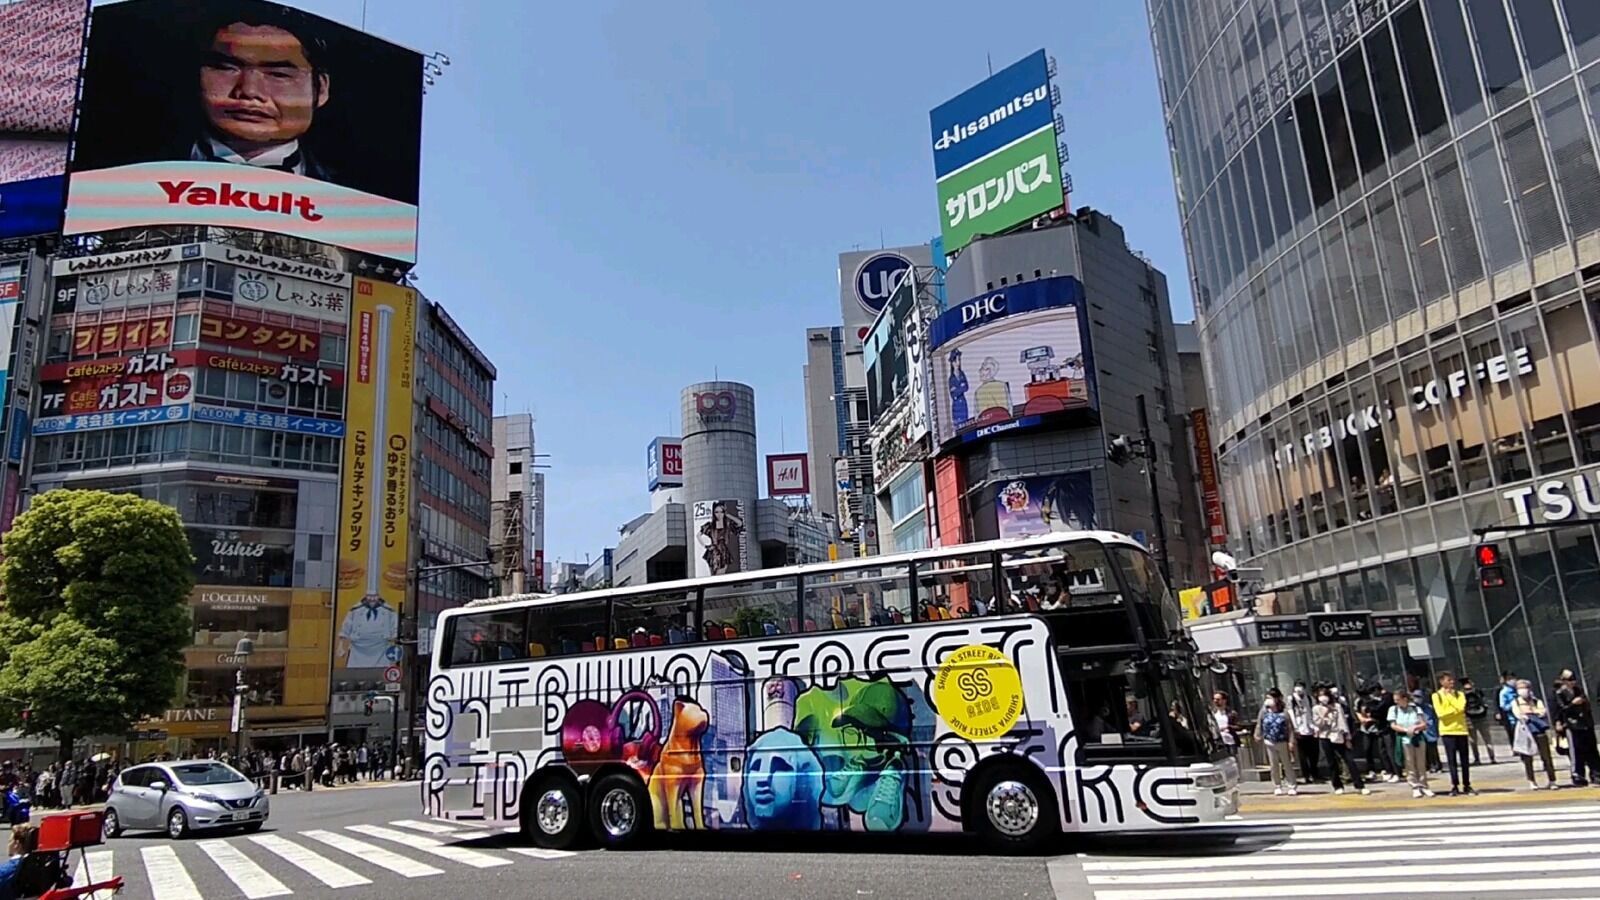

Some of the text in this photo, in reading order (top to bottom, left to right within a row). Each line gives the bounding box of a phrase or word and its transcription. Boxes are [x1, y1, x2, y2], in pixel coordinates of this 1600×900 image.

[934, 84, 1048, 150] Hisamitsu
[157, 180, 324, 223] Yakult
[946, 153, 1053, 228] サロンパス
[68, 248, 172, 272] しゃぶしゃぶバイキング
[225, 249, 345, 283] しゃぶしゃぶバイキング
[57, 288, 77, 303] 9F
[113, 272, 173, 297] しゃぶ葉
[275, 282, 344, 312] しゃぶ葉
[961, 294, 1006, 324] DHC
[76, 320, 168, 350] プライス
[201, 317, 316, 353] コンタクト
[126, 352, 175, 375] ガスト
[280, 364, 333, 387] ガスト
[43, 393, 66, 409] 7F
[99, 382, 158, 410] ガスト
[169, 384, 189, 394] ガスト
[75, 408, 163, 429] 英会話イーオン
[200, 407, 342, 434] AEON 英会話イーオン
[692, 391, 738, 421] 109
[976, 428, 992, 438] DHC
[991, 420, 1020, 433] Channel
[1274, 399, 1395, 470] STRBUCKS
[665, 448, 682, 459] UN
[665, 460, 682, 473] QL
[777, 466, 799, 482] H&M
[350, 430, 367, 552] ごはんチキンタツタ
[1503, 471, 1600, 526] TSU
[739, 531, 748, 572] hamasa
[958, 649, 986, 661] STREET
[957, 667, 993, 701] SS
[950, 694, 1019, 736] SHIBUYA STREET RIDE
